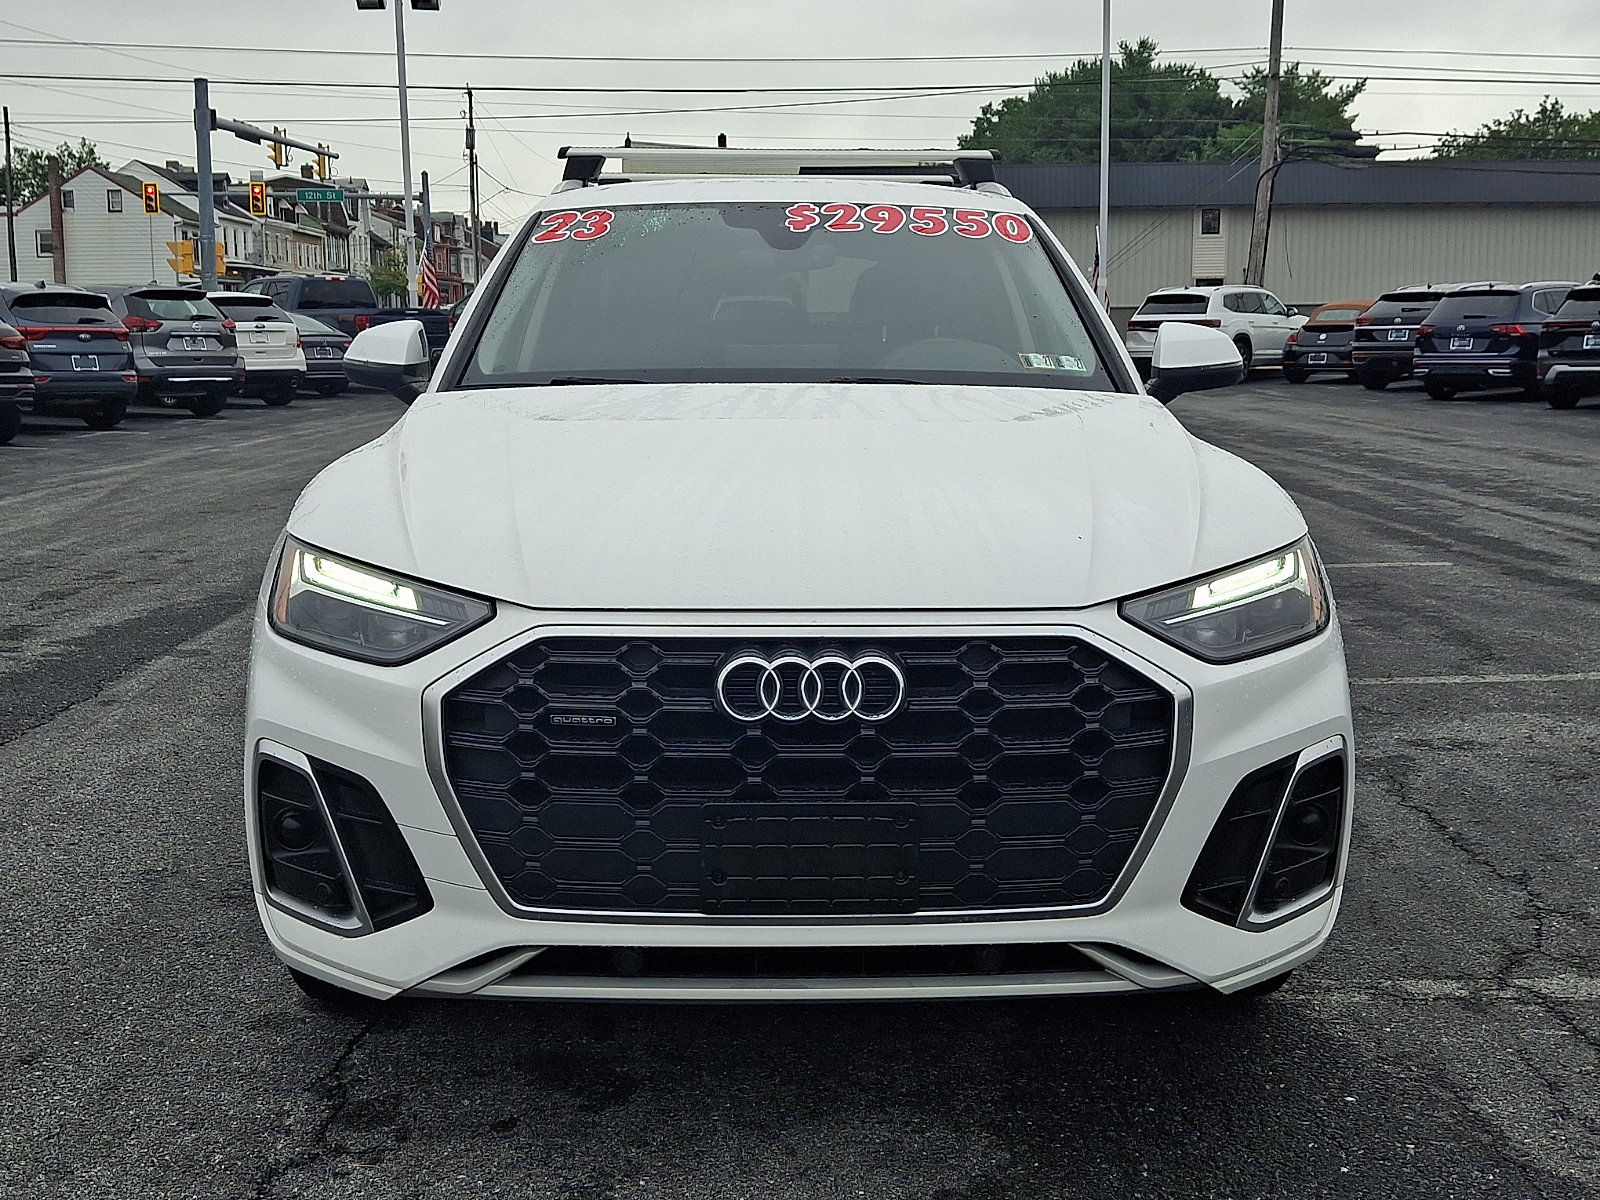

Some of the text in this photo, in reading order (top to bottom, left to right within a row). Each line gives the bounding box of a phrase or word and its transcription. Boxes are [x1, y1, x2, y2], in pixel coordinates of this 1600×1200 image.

[304, 191, 336, 200] 12th St
[531, 209, 615, 244] 23
[785, 202, 1034, 244] $29550
[553, 716, 613, 724] quattro
